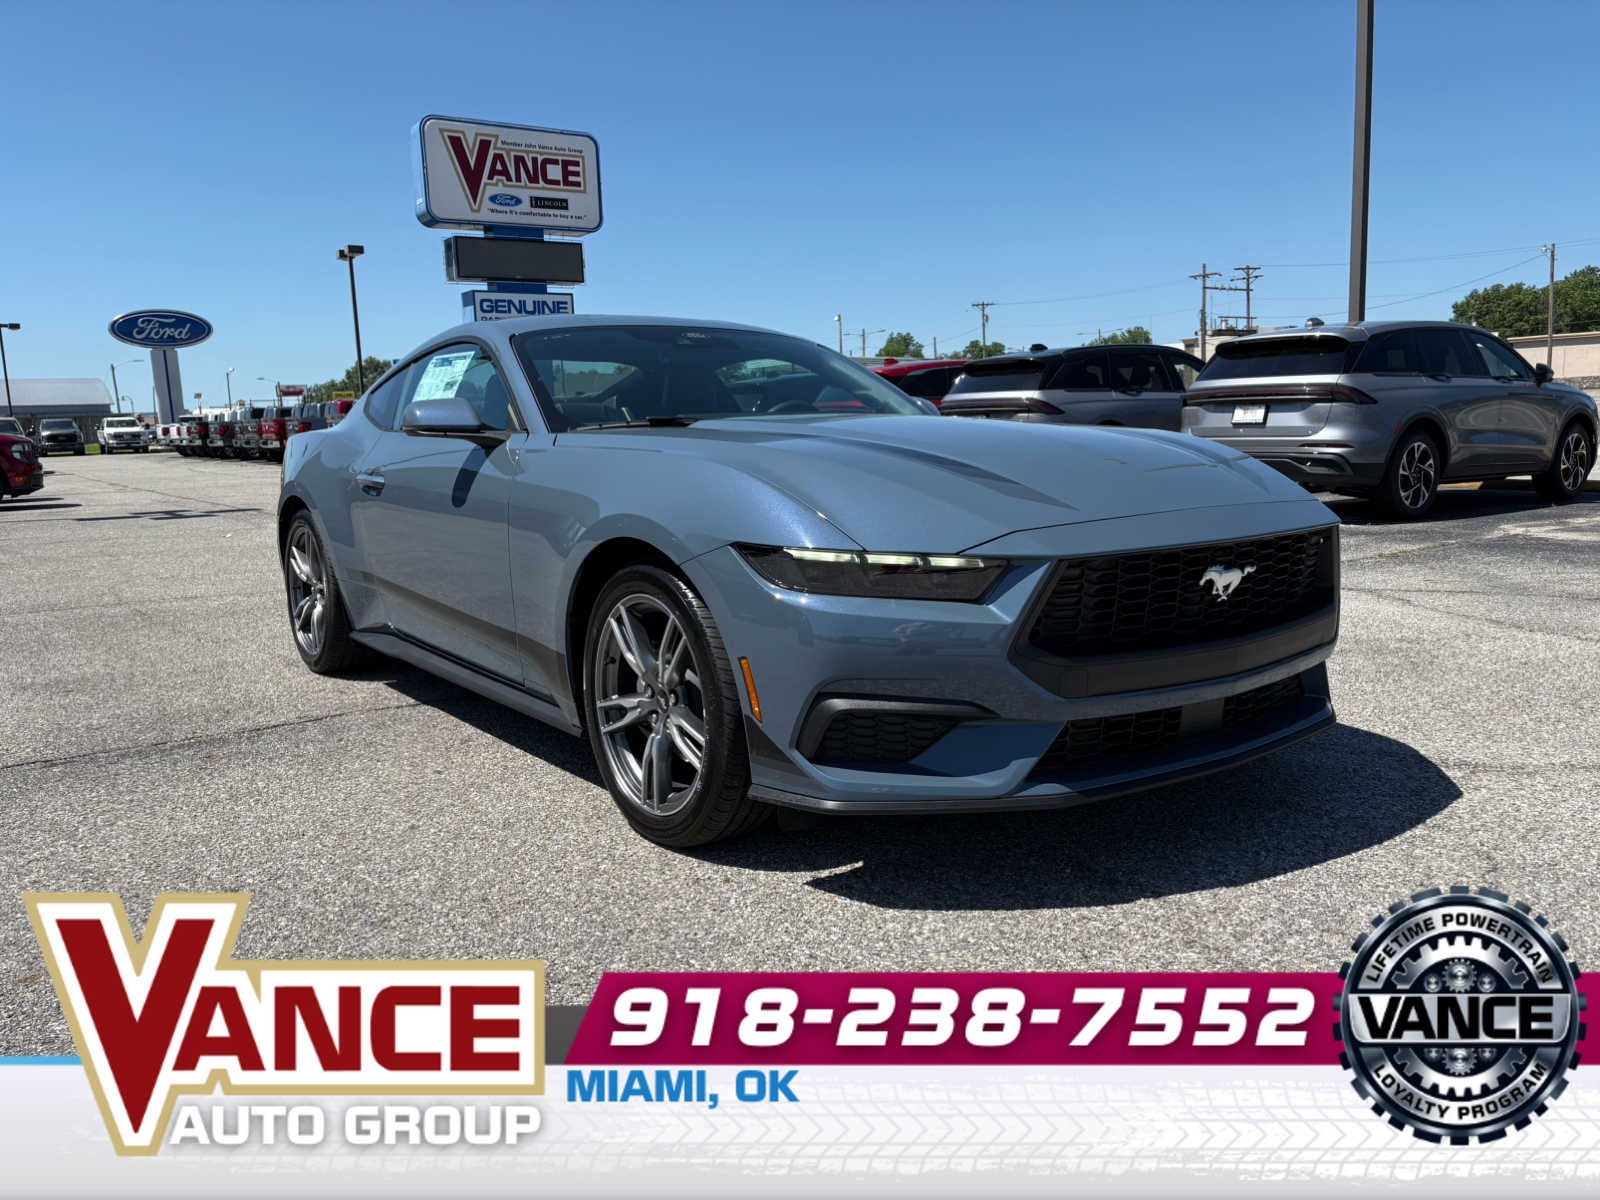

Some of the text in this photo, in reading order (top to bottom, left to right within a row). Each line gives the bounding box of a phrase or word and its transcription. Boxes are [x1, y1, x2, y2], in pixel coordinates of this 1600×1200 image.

[501, 140, 523, 148] Member
[447, 135, 582, 206] VANCE
[495, 193, 517, 206] Ford
[537, 199, 567, 208] LINCOLN
[479, 298, 569, 316] GENUINE
[133, 316, 191, 340] Ford
